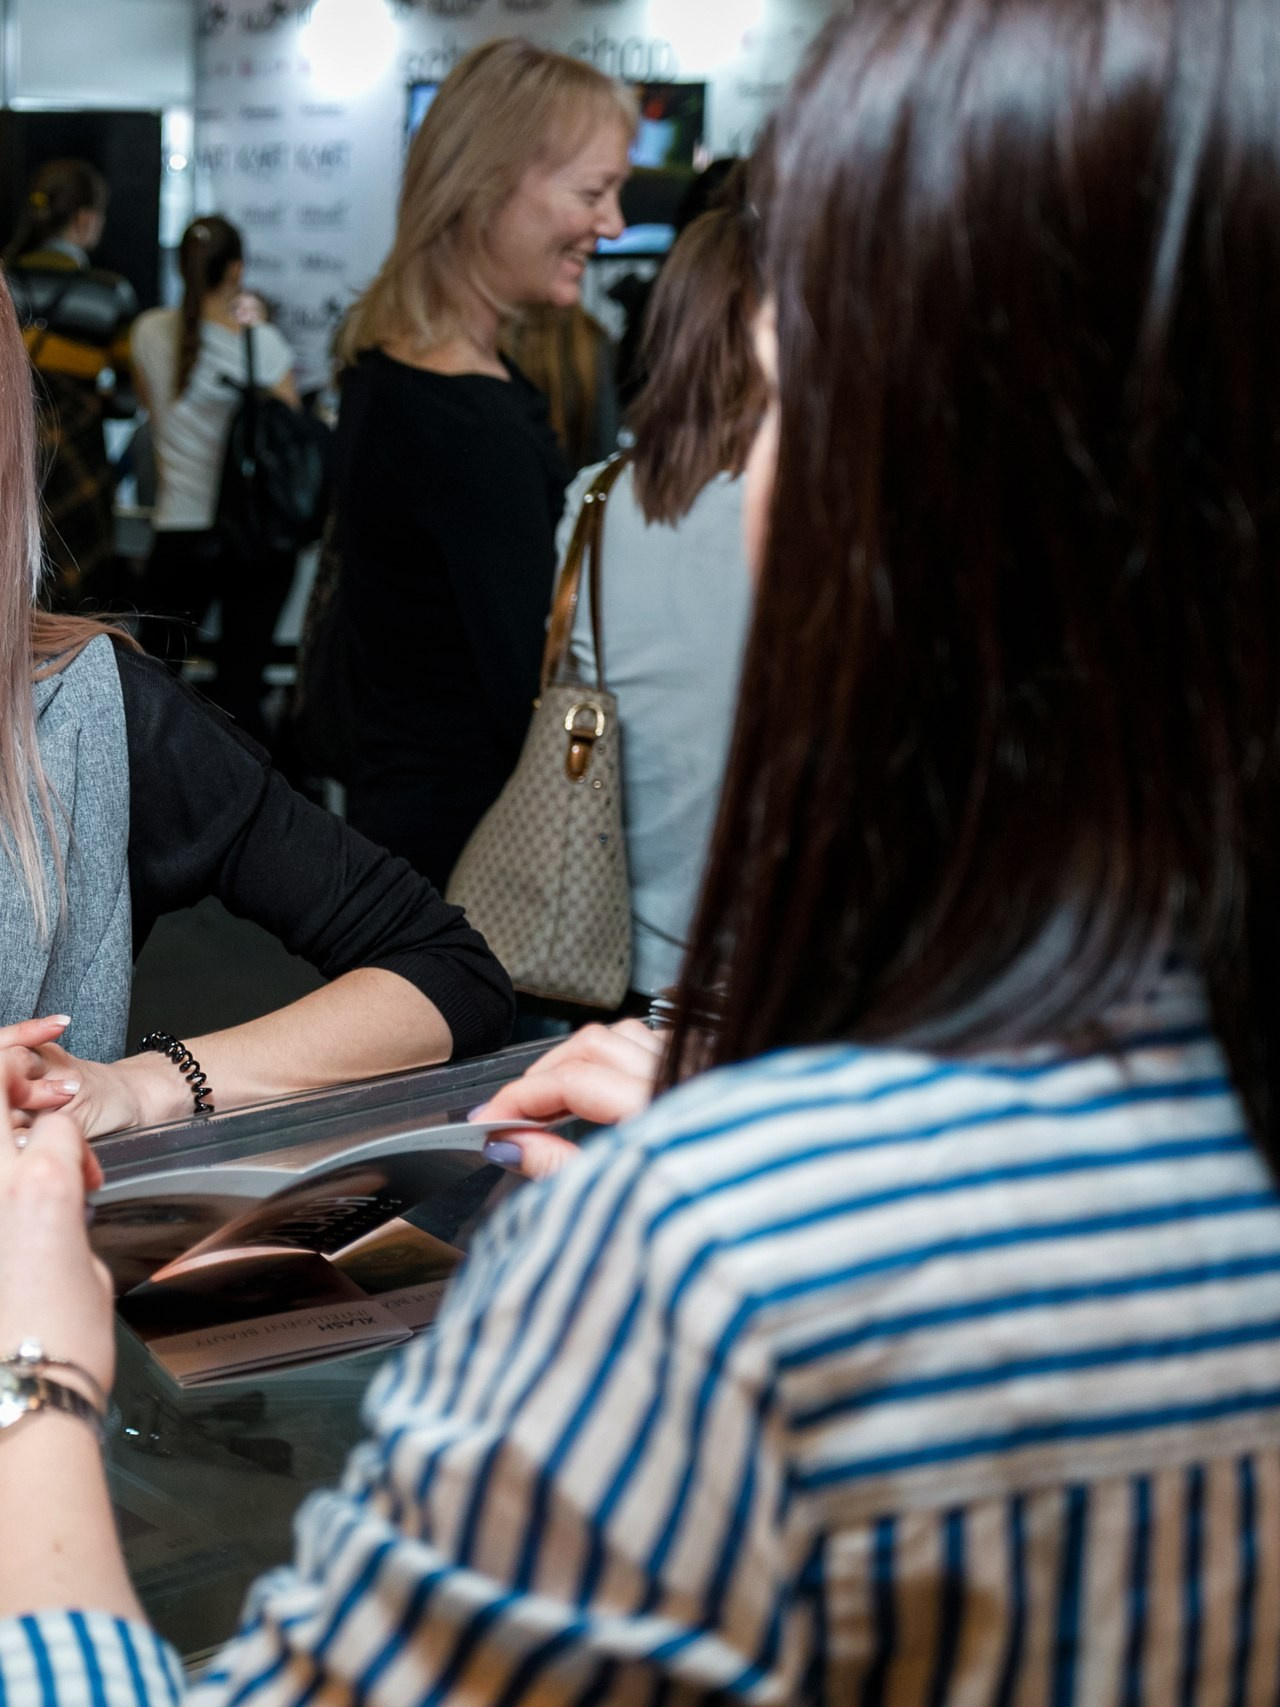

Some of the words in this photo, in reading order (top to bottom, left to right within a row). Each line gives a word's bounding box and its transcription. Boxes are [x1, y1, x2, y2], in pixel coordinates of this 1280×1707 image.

[264, 1309, 369, 1333] INTELLIGENT
[317, 1315, 377, 1333] XLASH
[195, 1327, 258, 1348] BEAUTY
